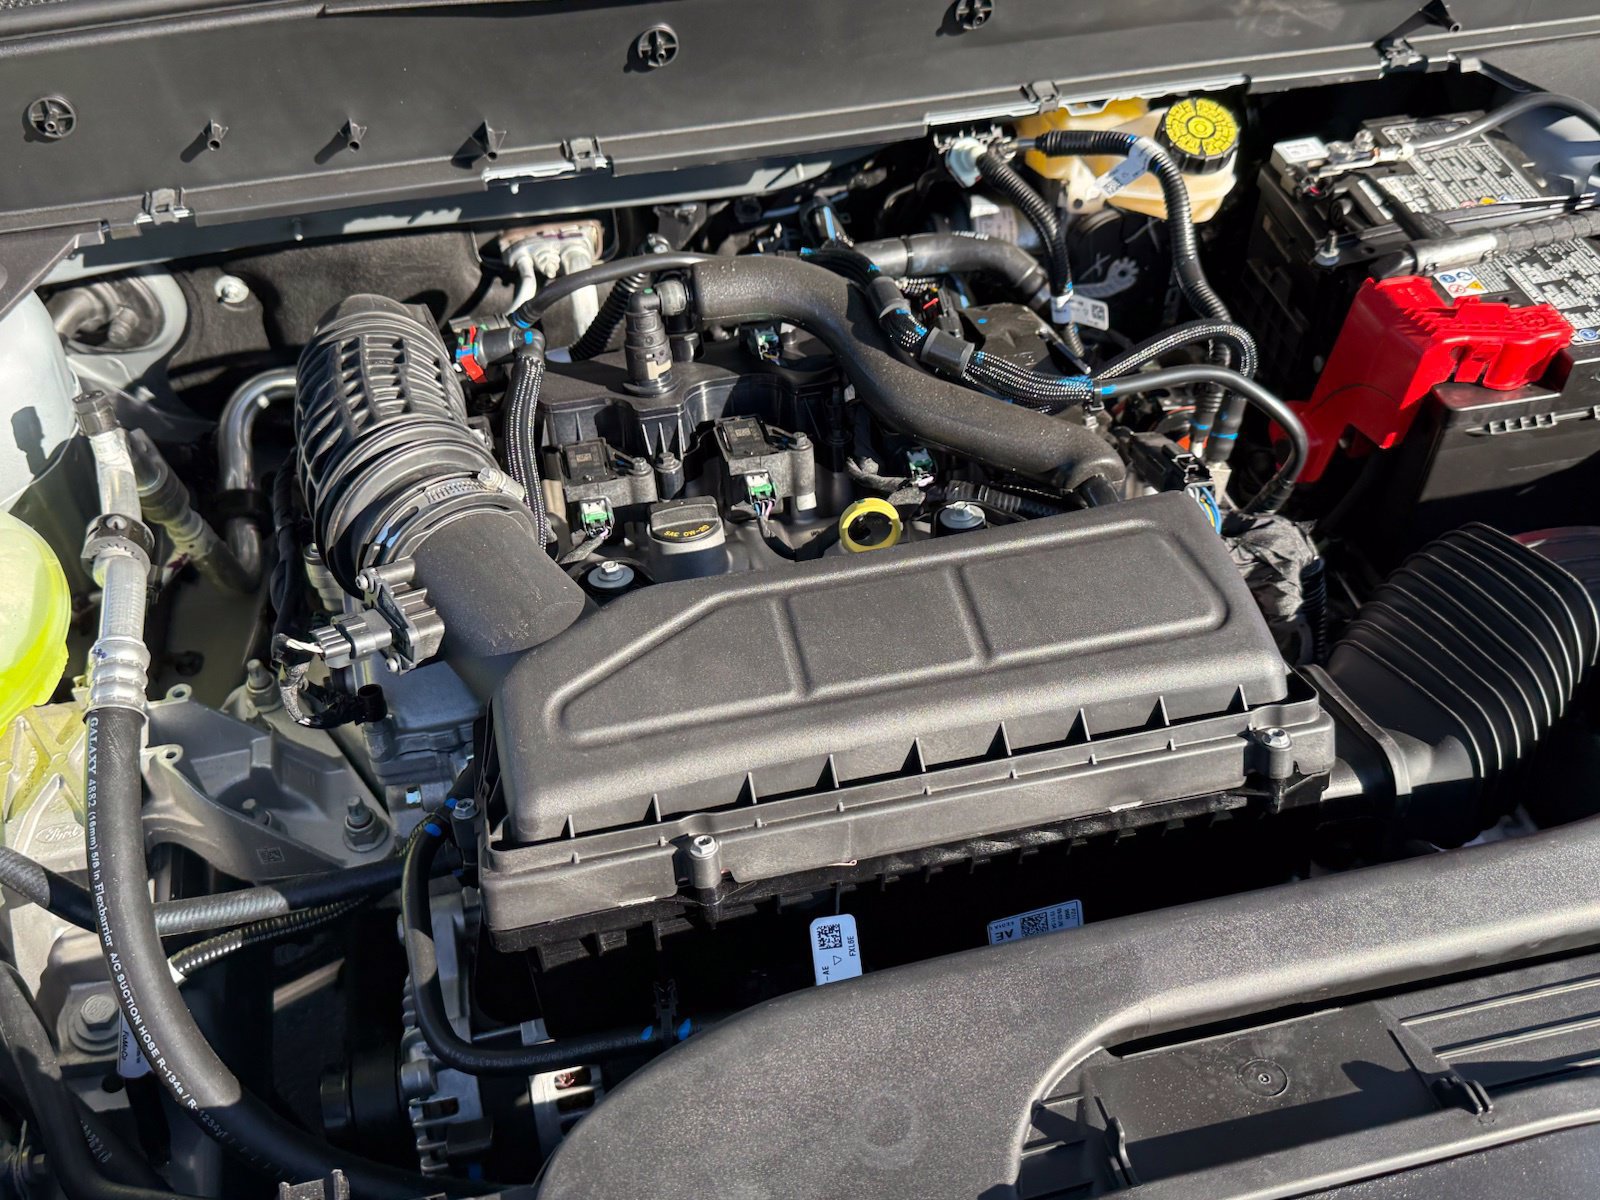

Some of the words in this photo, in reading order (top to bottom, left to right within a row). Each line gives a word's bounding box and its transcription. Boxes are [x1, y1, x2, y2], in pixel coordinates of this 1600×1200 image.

[88, 717, 99, 775] GALAXY
[88, 779, 97, 808] 4882
[94, 882, 114, 948] Flexbarrier
[110, 952, 122, 972] A/C
[116, 973, 143, 1026] SUCTION
[139, 1025, 160, 1058] HOSE
[157, 1057, 184, 1095] R-134a
